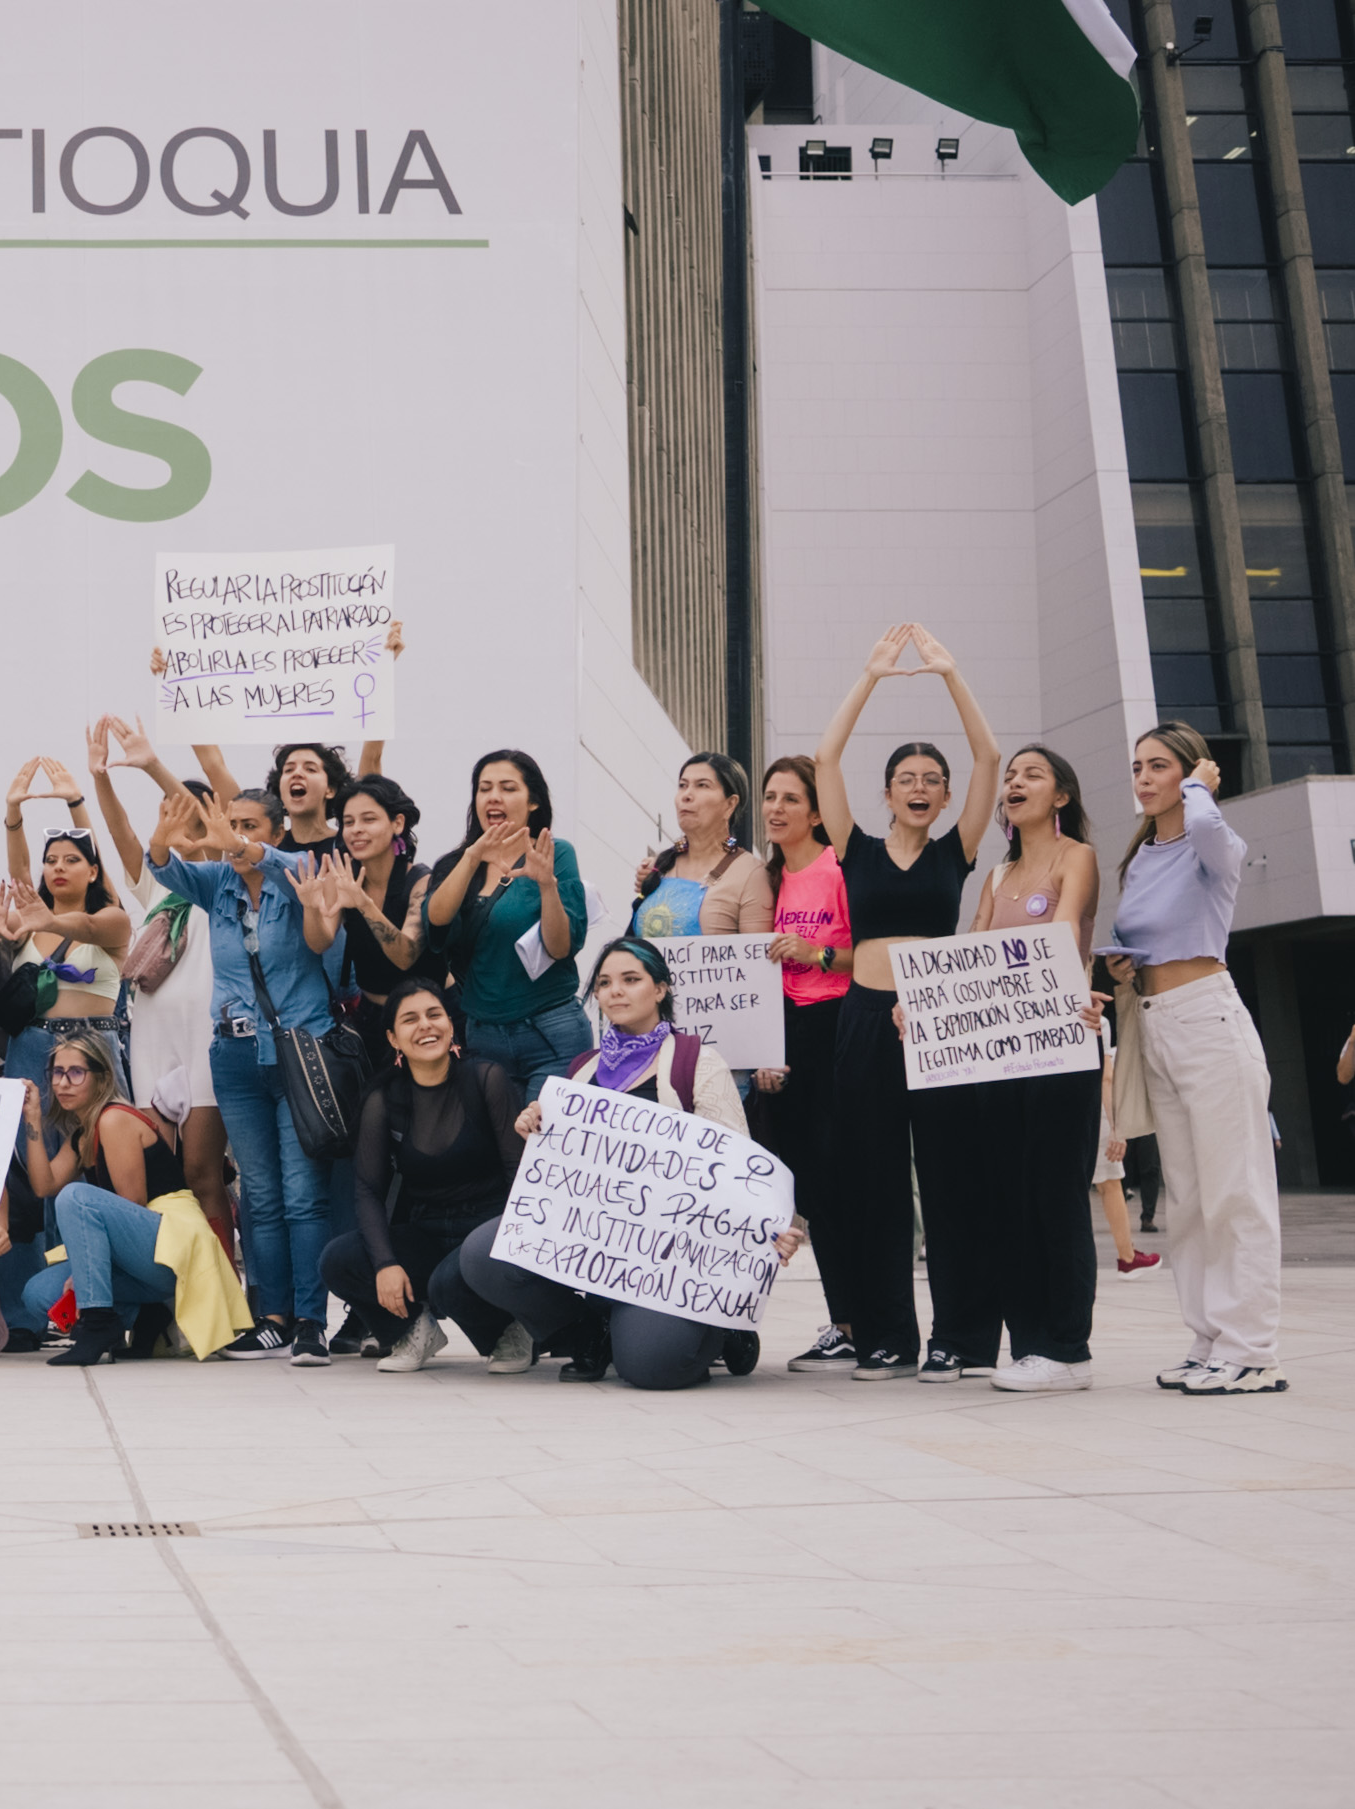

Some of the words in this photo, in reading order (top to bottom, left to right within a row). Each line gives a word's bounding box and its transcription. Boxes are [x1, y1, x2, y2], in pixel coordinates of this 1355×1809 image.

[165, 568, 252, 606] REGULAR
[255, 573, 278, 606] LA
[280, 565, 386, 604] PROSTITUCIÓN
[162, 612, 188, 635] ES
[190, 611, 277, 639] PROTEGER
[301, 603, 392, 634] PATRIARCADO
[251, 650, 277, 672] ES
[283, 639, 368, 674] PROTEGER
[173, 685, 190, 713] A
[196, 684, 234, 711] LAS
[244, 678, 335, 713] MUJERES
[701, 944, 738, 965] PARA
[898, 952, 924, 980] LA
[921, 943, 997, 976] DIGNIDAD
[1001, 938, 1028, 966] NO
[1032, 937, 1056, 962] SE
[686, 992, 726, 1016] PARA
[730, 993, 761, 1011] SER
[906, 978, 950, 1013] HARÁ
[952, 971, 1036, 1005] COSTUMBRE
[1041, 968, 1059, 993] SI
[909, 1020, 929, 1045] LA
[932, 1002, 1011, 1041] EXPLOTACIÓN
[1013, 996, 1062, 1024] SEXUAL
[1063, 993, 1083, 1017] SE
[917, 1042, 985, 1074] LEGITIMA
[985, 1034, 1022, 1061] COMO
[1023, 1021, 1086, 1055] TRABAJO
[536, 1122, 727, 1192] ACTIVIDADES
[697, 1127, 733, 1155] DE
[525, 1158, 653, 1217] SEXUALES
[502, 1222, 524, 1236] DE
[510, 1195, 553, 1225] ES
[532, 1237, 678, 1302] EXPLOTACIÓN
[674, 1278, 760, 1324] SEXUAL
